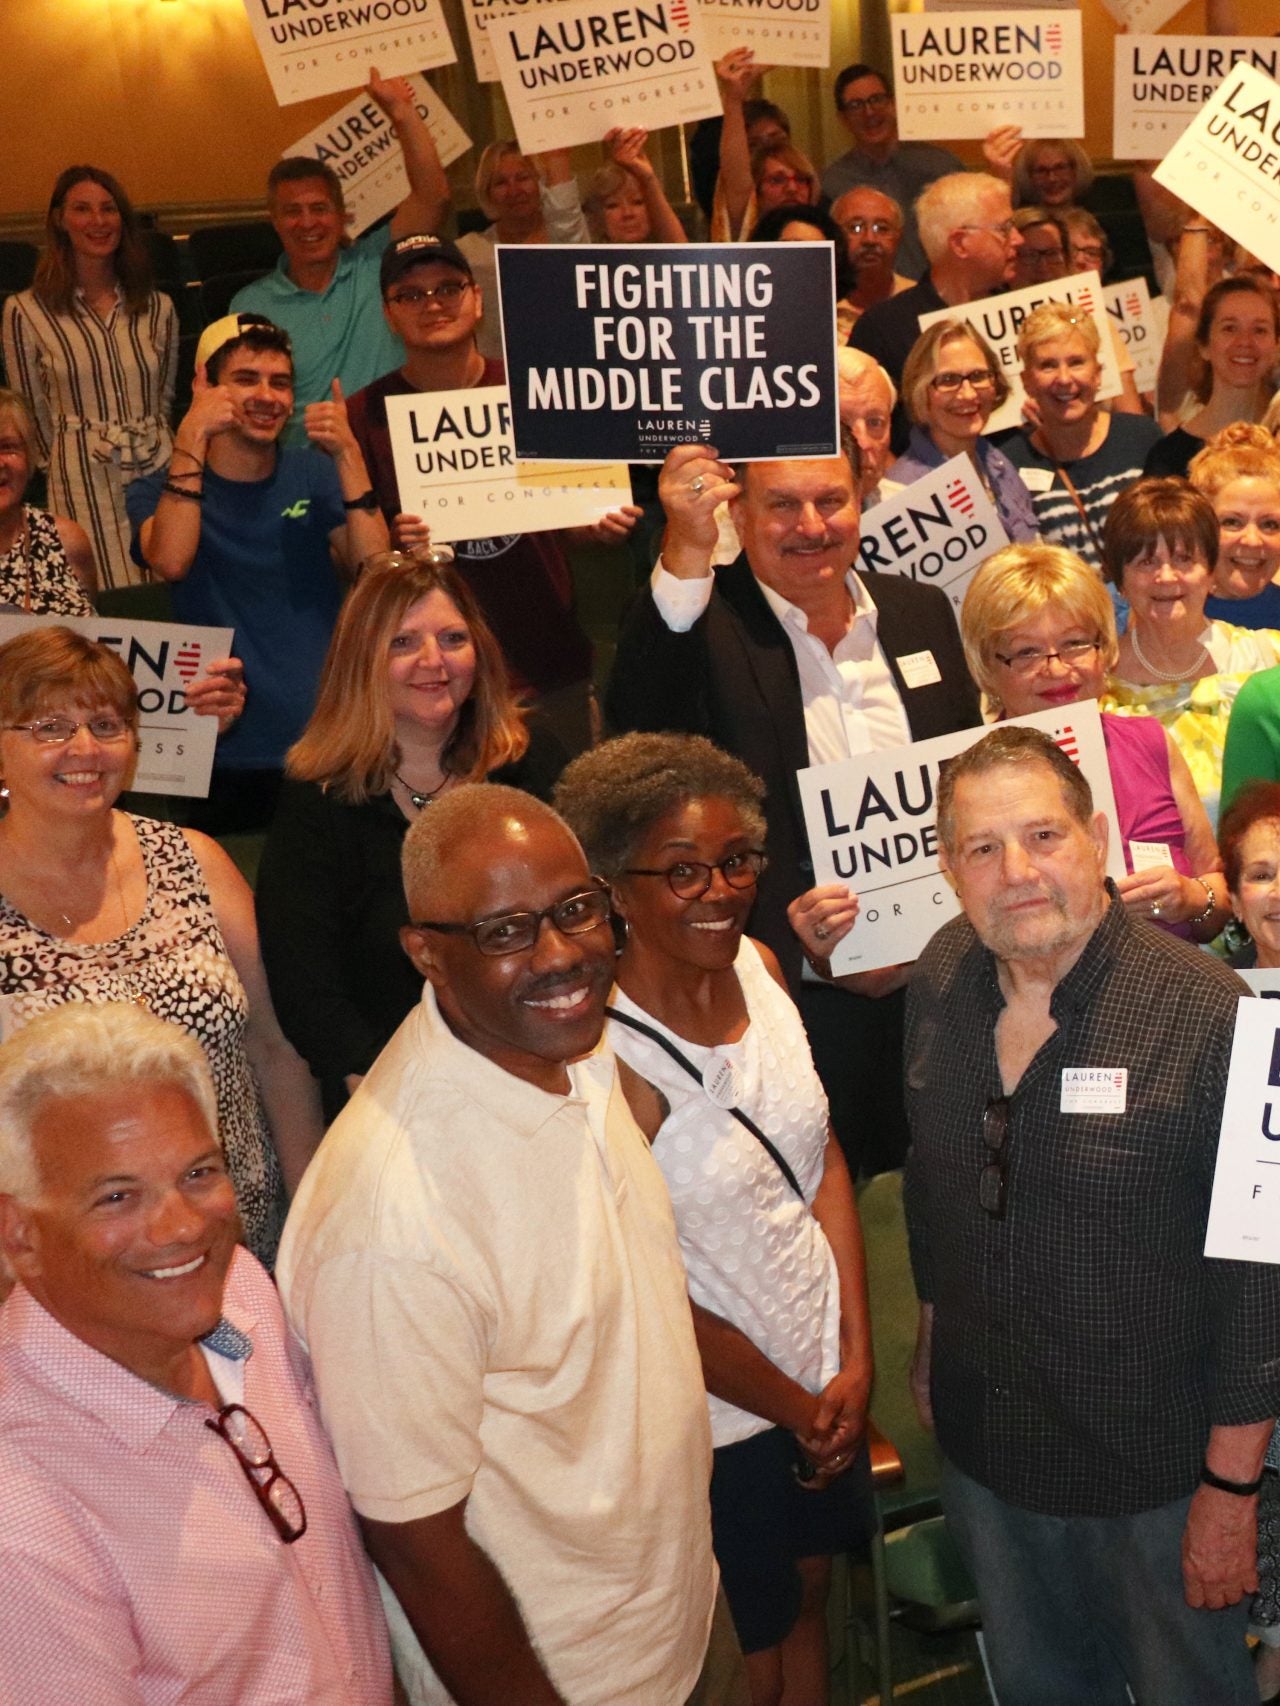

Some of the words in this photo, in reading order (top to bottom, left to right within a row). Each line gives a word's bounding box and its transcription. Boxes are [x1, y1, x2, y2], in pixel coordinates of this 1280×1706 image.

[271, 0, 428, 44] UNDERWOOD
[509, 4, 669, 61] LAUREN
[901, 25, 1041, 57] LAUREN
[284, 59, 319, 73] FOR
[335, 31, 438, 62] CONGRESS
[520, 39, 695, 88] UNDERWOOD
[903, 61, 1062, 84] UNDERWOOD
[531, 106, 569, 121] FOR
[589, 80, 705, 112] CONGRESS
[905, 104, 940, 114] FOR
[957, 101, 1064, 113] CONGRESS
[315, 103, 385, 162] AURE
[1184, 151, 1221, 181] FOR
[575, 263, 773, 309] FIGHTING
[593, 316, 676, 361] FOR
[688, 315, 767, 359] THE
[528, 367, 684, 411] MIDDLE
[699, 364, 821, 410] CLASS
[409, 402, 511, 444] LAUR
[637, 419, 696, 431] LAUREN
[638, 434, 699, 442] UNDERWOOD
[416, 445, 530, 474] UNDER
[422, 496, 465, 509] FOR
[487, 479, 617, 504] CONGRESS
[820, 757, 950, 838] LAU
[866, 903, 903, 924] OR
[1065, 1072, 1112, 1082] LAUREN
